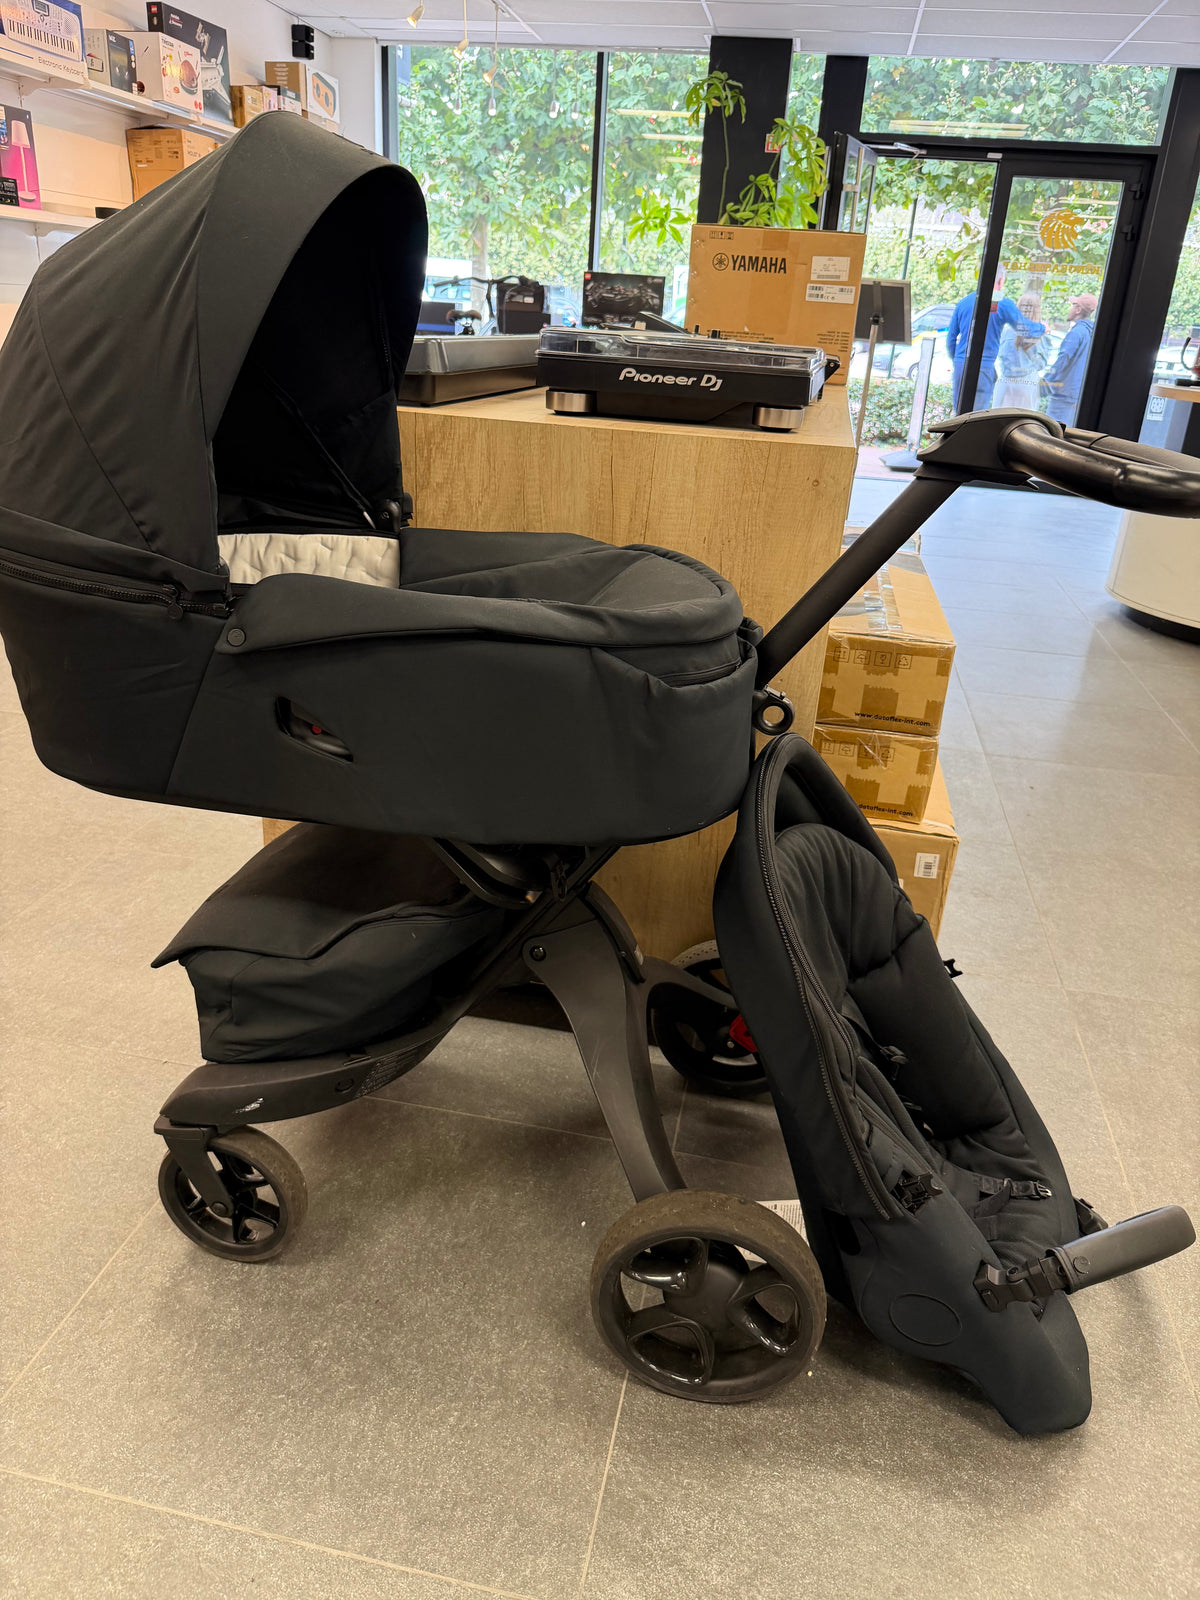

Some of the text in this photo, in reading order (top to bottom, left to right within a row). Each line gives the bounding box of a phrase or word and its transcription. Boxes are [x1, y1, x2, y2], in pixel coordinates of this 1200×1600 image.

[38, 56, 84, 77] Electronic Keyboard
[731, 254, 787, 274] YAMAHA
[618, 367, 697, 386] Pioneer
[854, 711, 931, 727] www.dataflex-int.com
[858, 803, 913, 817] dataflex-int.com
